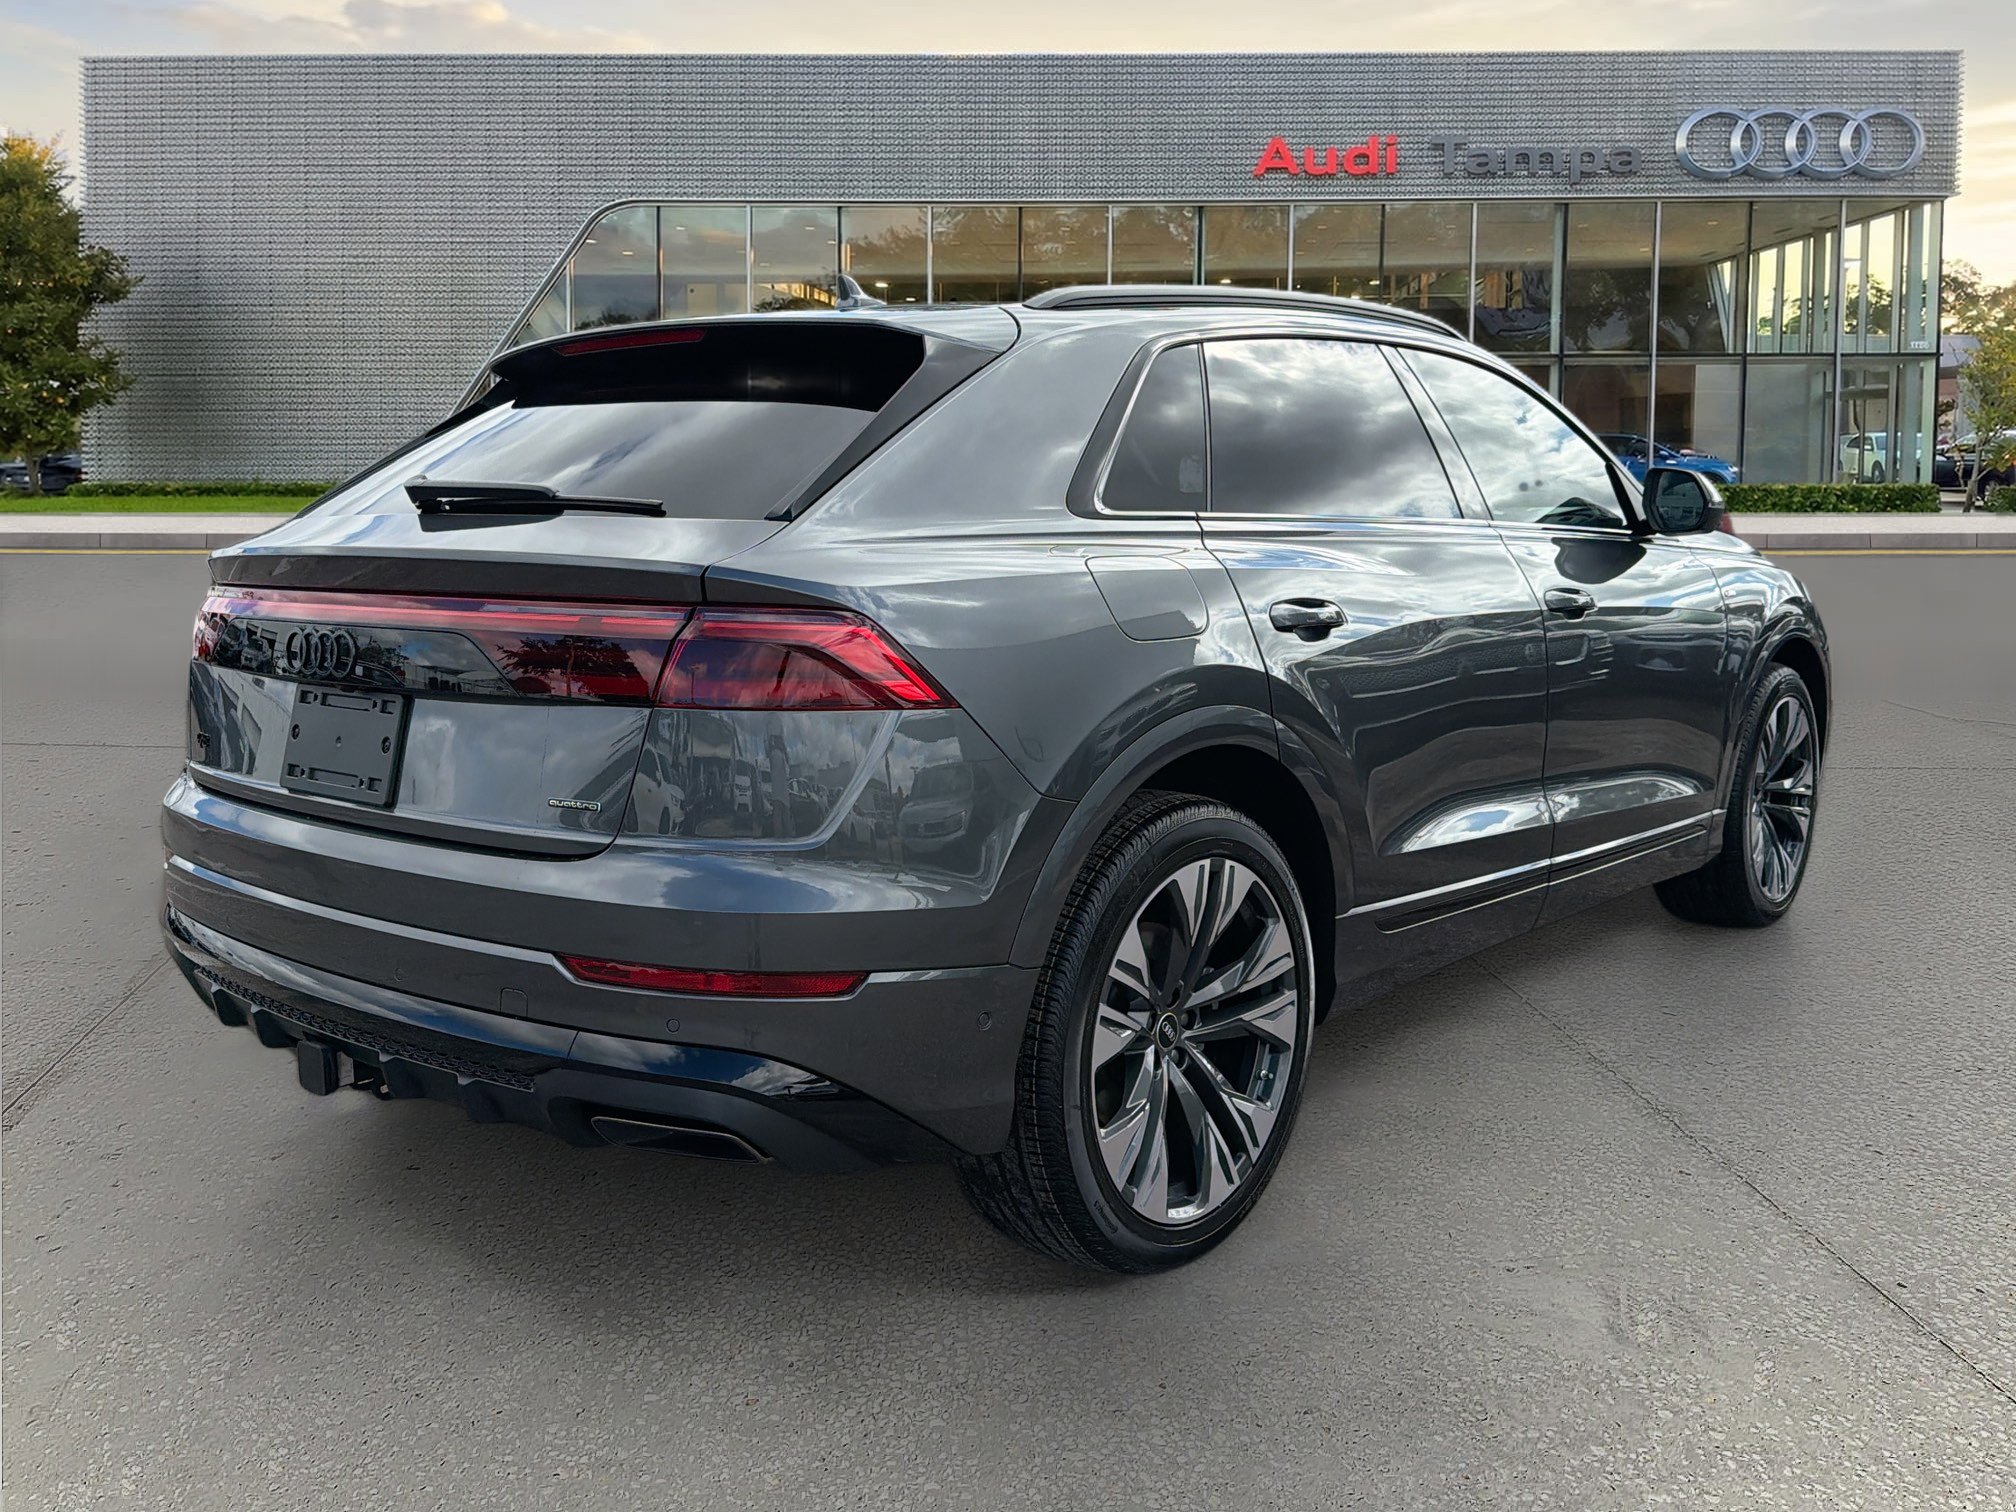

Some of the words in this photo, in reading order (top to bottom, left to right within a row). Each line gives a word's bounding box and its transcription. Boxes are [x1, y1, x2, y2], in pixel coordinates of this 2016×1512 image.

[1254, 135, 1398, 177] Audi
[1431, 135, 1643, 184] Tampa
[549, 799, 598, 811] quattro
